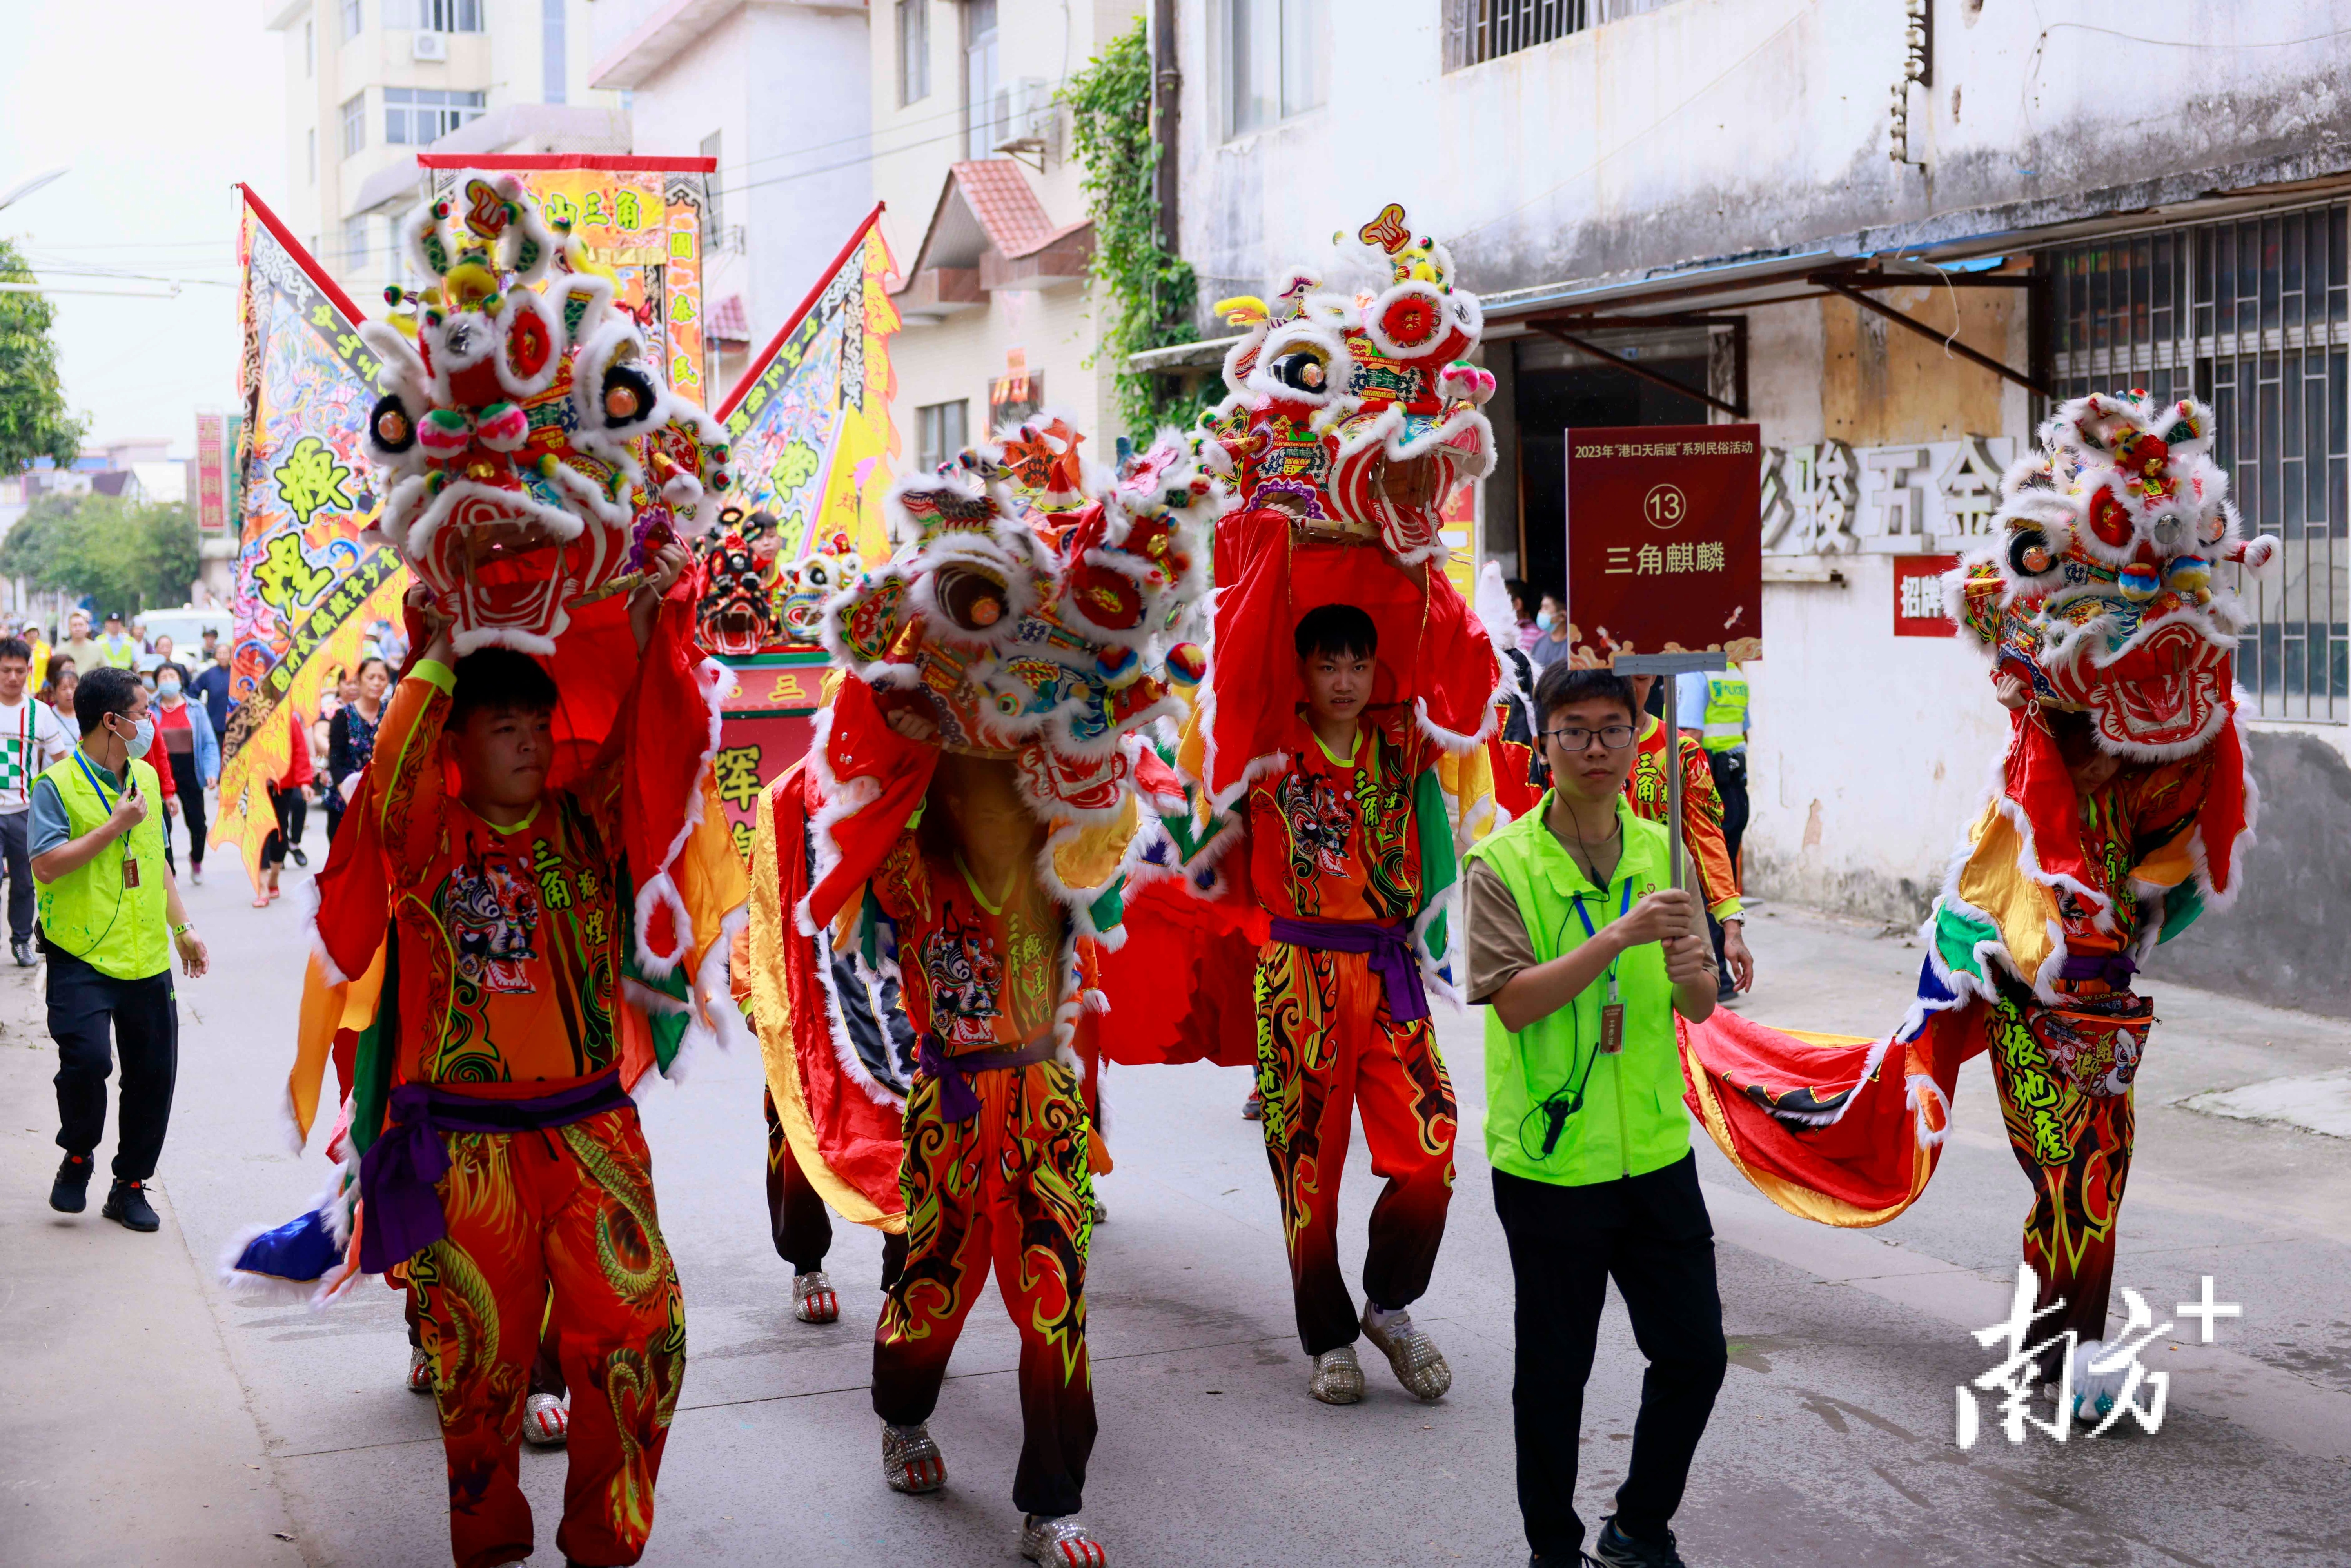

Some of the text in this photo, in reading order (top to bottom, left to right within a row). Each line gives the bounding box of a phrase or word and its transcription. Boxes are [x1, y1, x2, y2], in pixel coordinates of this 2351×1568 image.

[523, 187, 641, 230] 山三角
[1604, 541, 1725, 575] 三角麒麟
[1353, 770, 1380, 827] 三角
[1636, 753, 1658, 802] 三角
[532, 839, 572, 909] 三角
